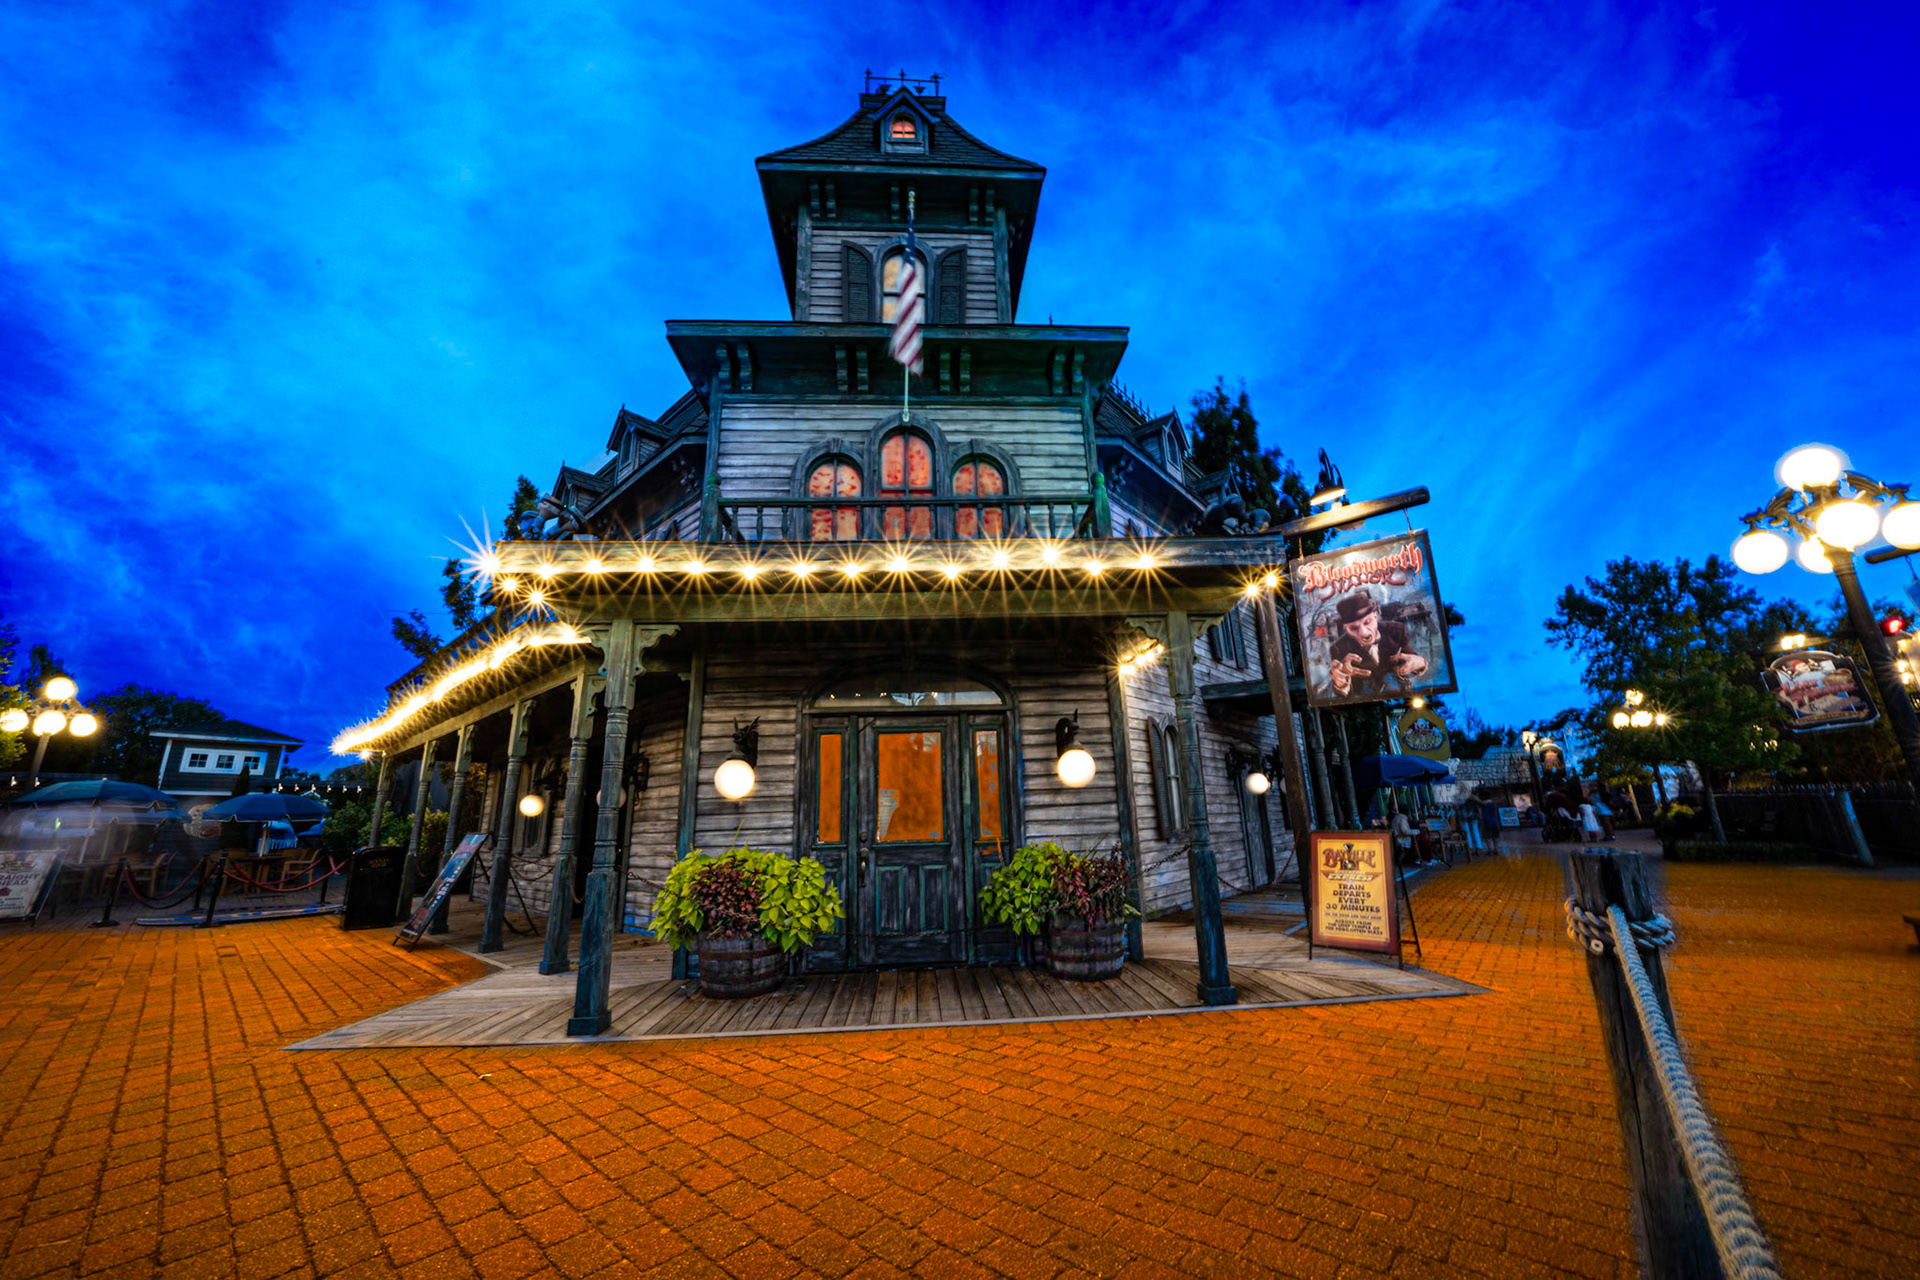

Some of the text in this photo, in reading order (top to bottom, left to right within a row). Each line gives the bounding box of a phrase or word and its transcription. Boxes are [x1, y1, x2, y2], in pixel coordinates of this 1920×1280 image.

[1298, 543, 1423, 593] Bloodworth
[1318, 567, 1407, 602] MANOR
[1323, 848, 1376, 868] BAYVILLE
[1333, 890, 1371, 898] DEPARTS
[1340, 904, 1380, 913] MINUTES
